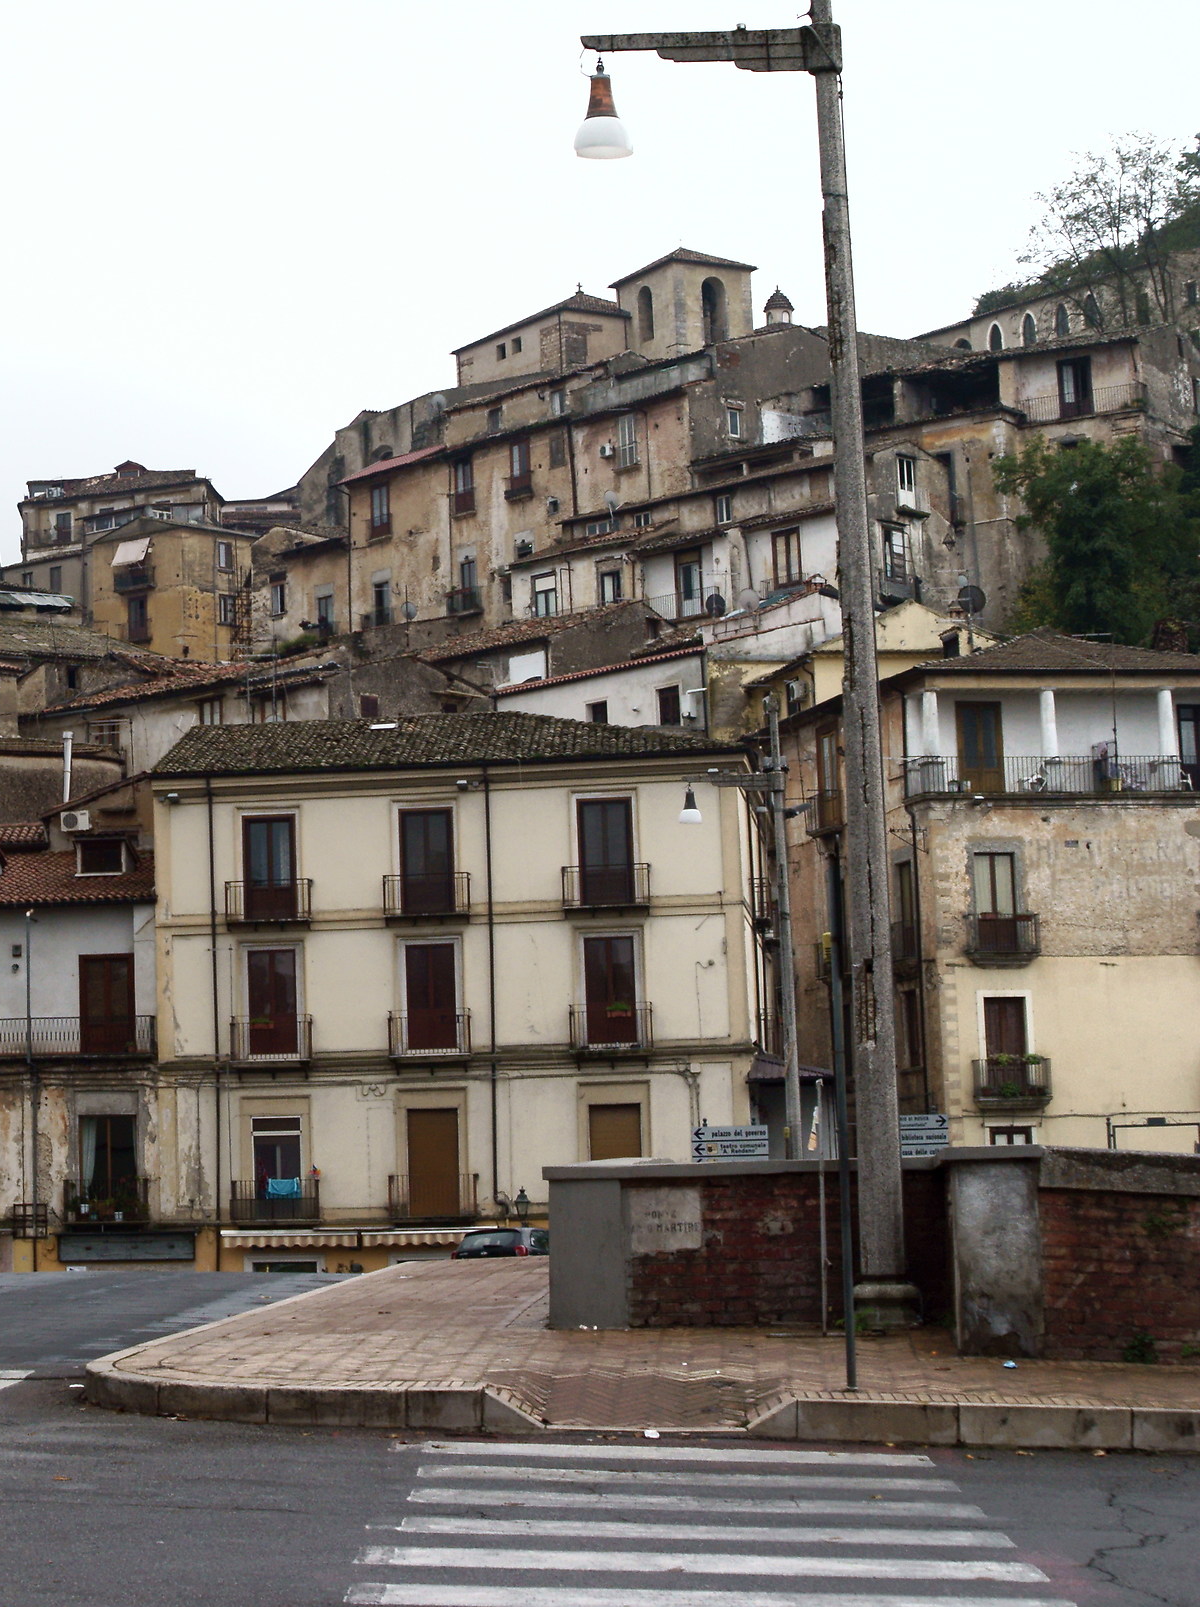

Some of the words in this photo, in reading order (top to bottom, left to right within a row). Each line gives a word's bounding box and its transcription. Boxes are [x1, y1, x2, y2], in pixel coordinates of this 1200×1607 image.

[711, 1130, 732, 1138] palazzo
[733, 1129, 743, 1137] del
[745, 1130, 766, 1138] governo
